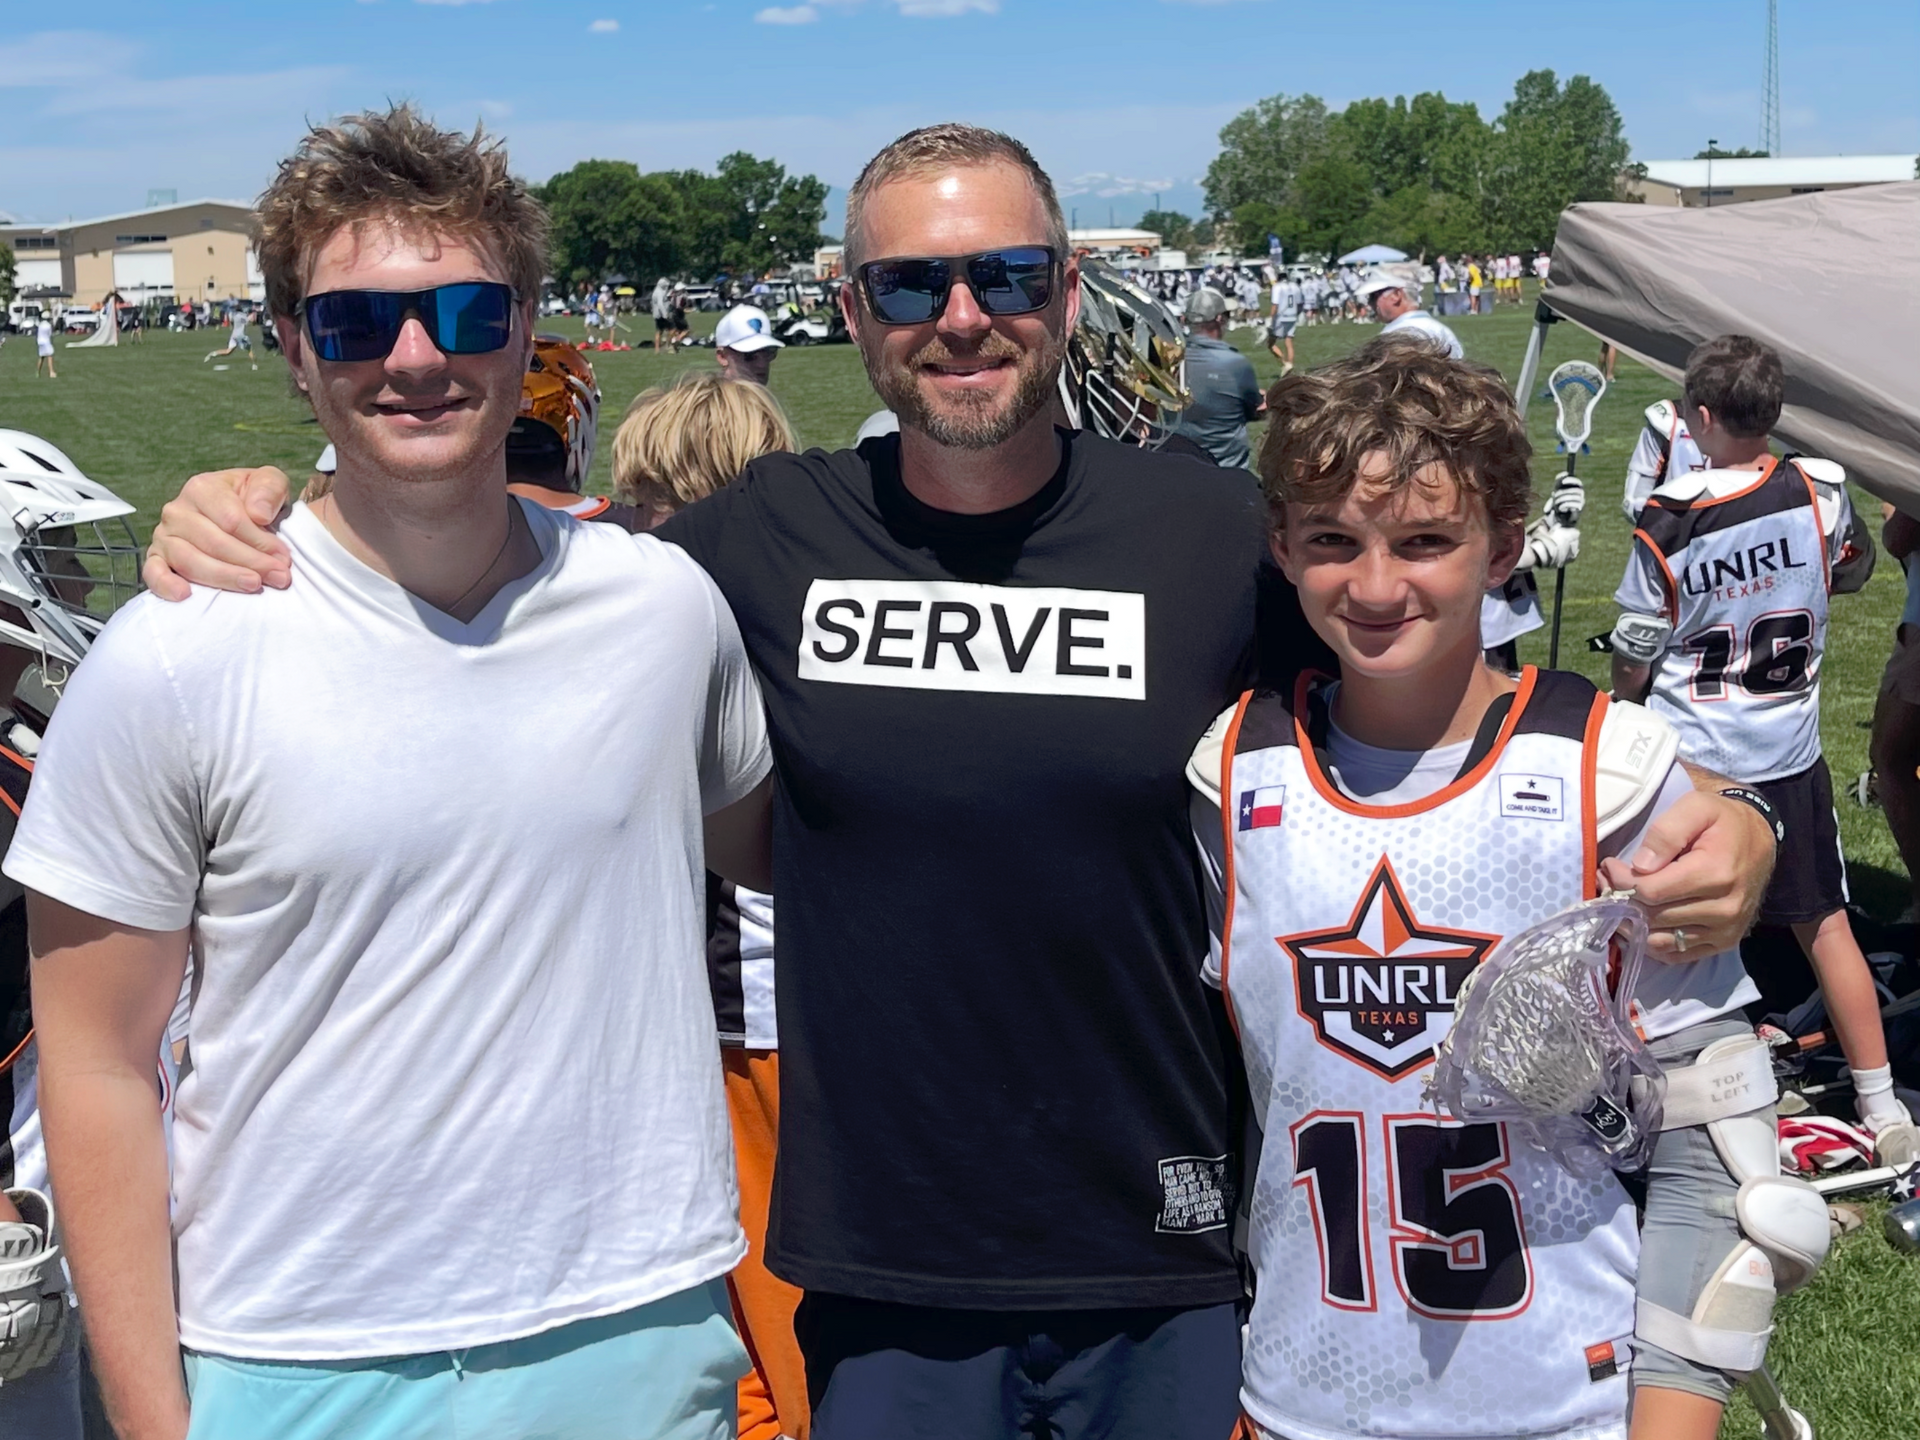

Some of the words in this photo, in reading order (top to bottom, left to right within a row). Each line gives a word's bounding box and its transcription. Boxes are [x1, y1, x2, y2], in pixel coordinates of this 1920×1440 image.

[1683, 537, 1807, 596] UNRL
[1715, 576, 1775, 602] TEXAS
[812, 598, 1132, 680] SERVE.
[1682, 607, 1815, 702] 16
[1624, 730, 1652, 769] STX
[1506, 803, 1523, 811] COME
[1537, 806, 1551, 814] TAKE
[1313, 964, 1459, 1005] UNRL
[1358, 1010, 1419, 1025] TEXAS
[1711, 1083, 1750, 1103] LEFT
[1712, 1071, 1744, 1087] TOP
[1289, 1109, 1535, 1322] 15
